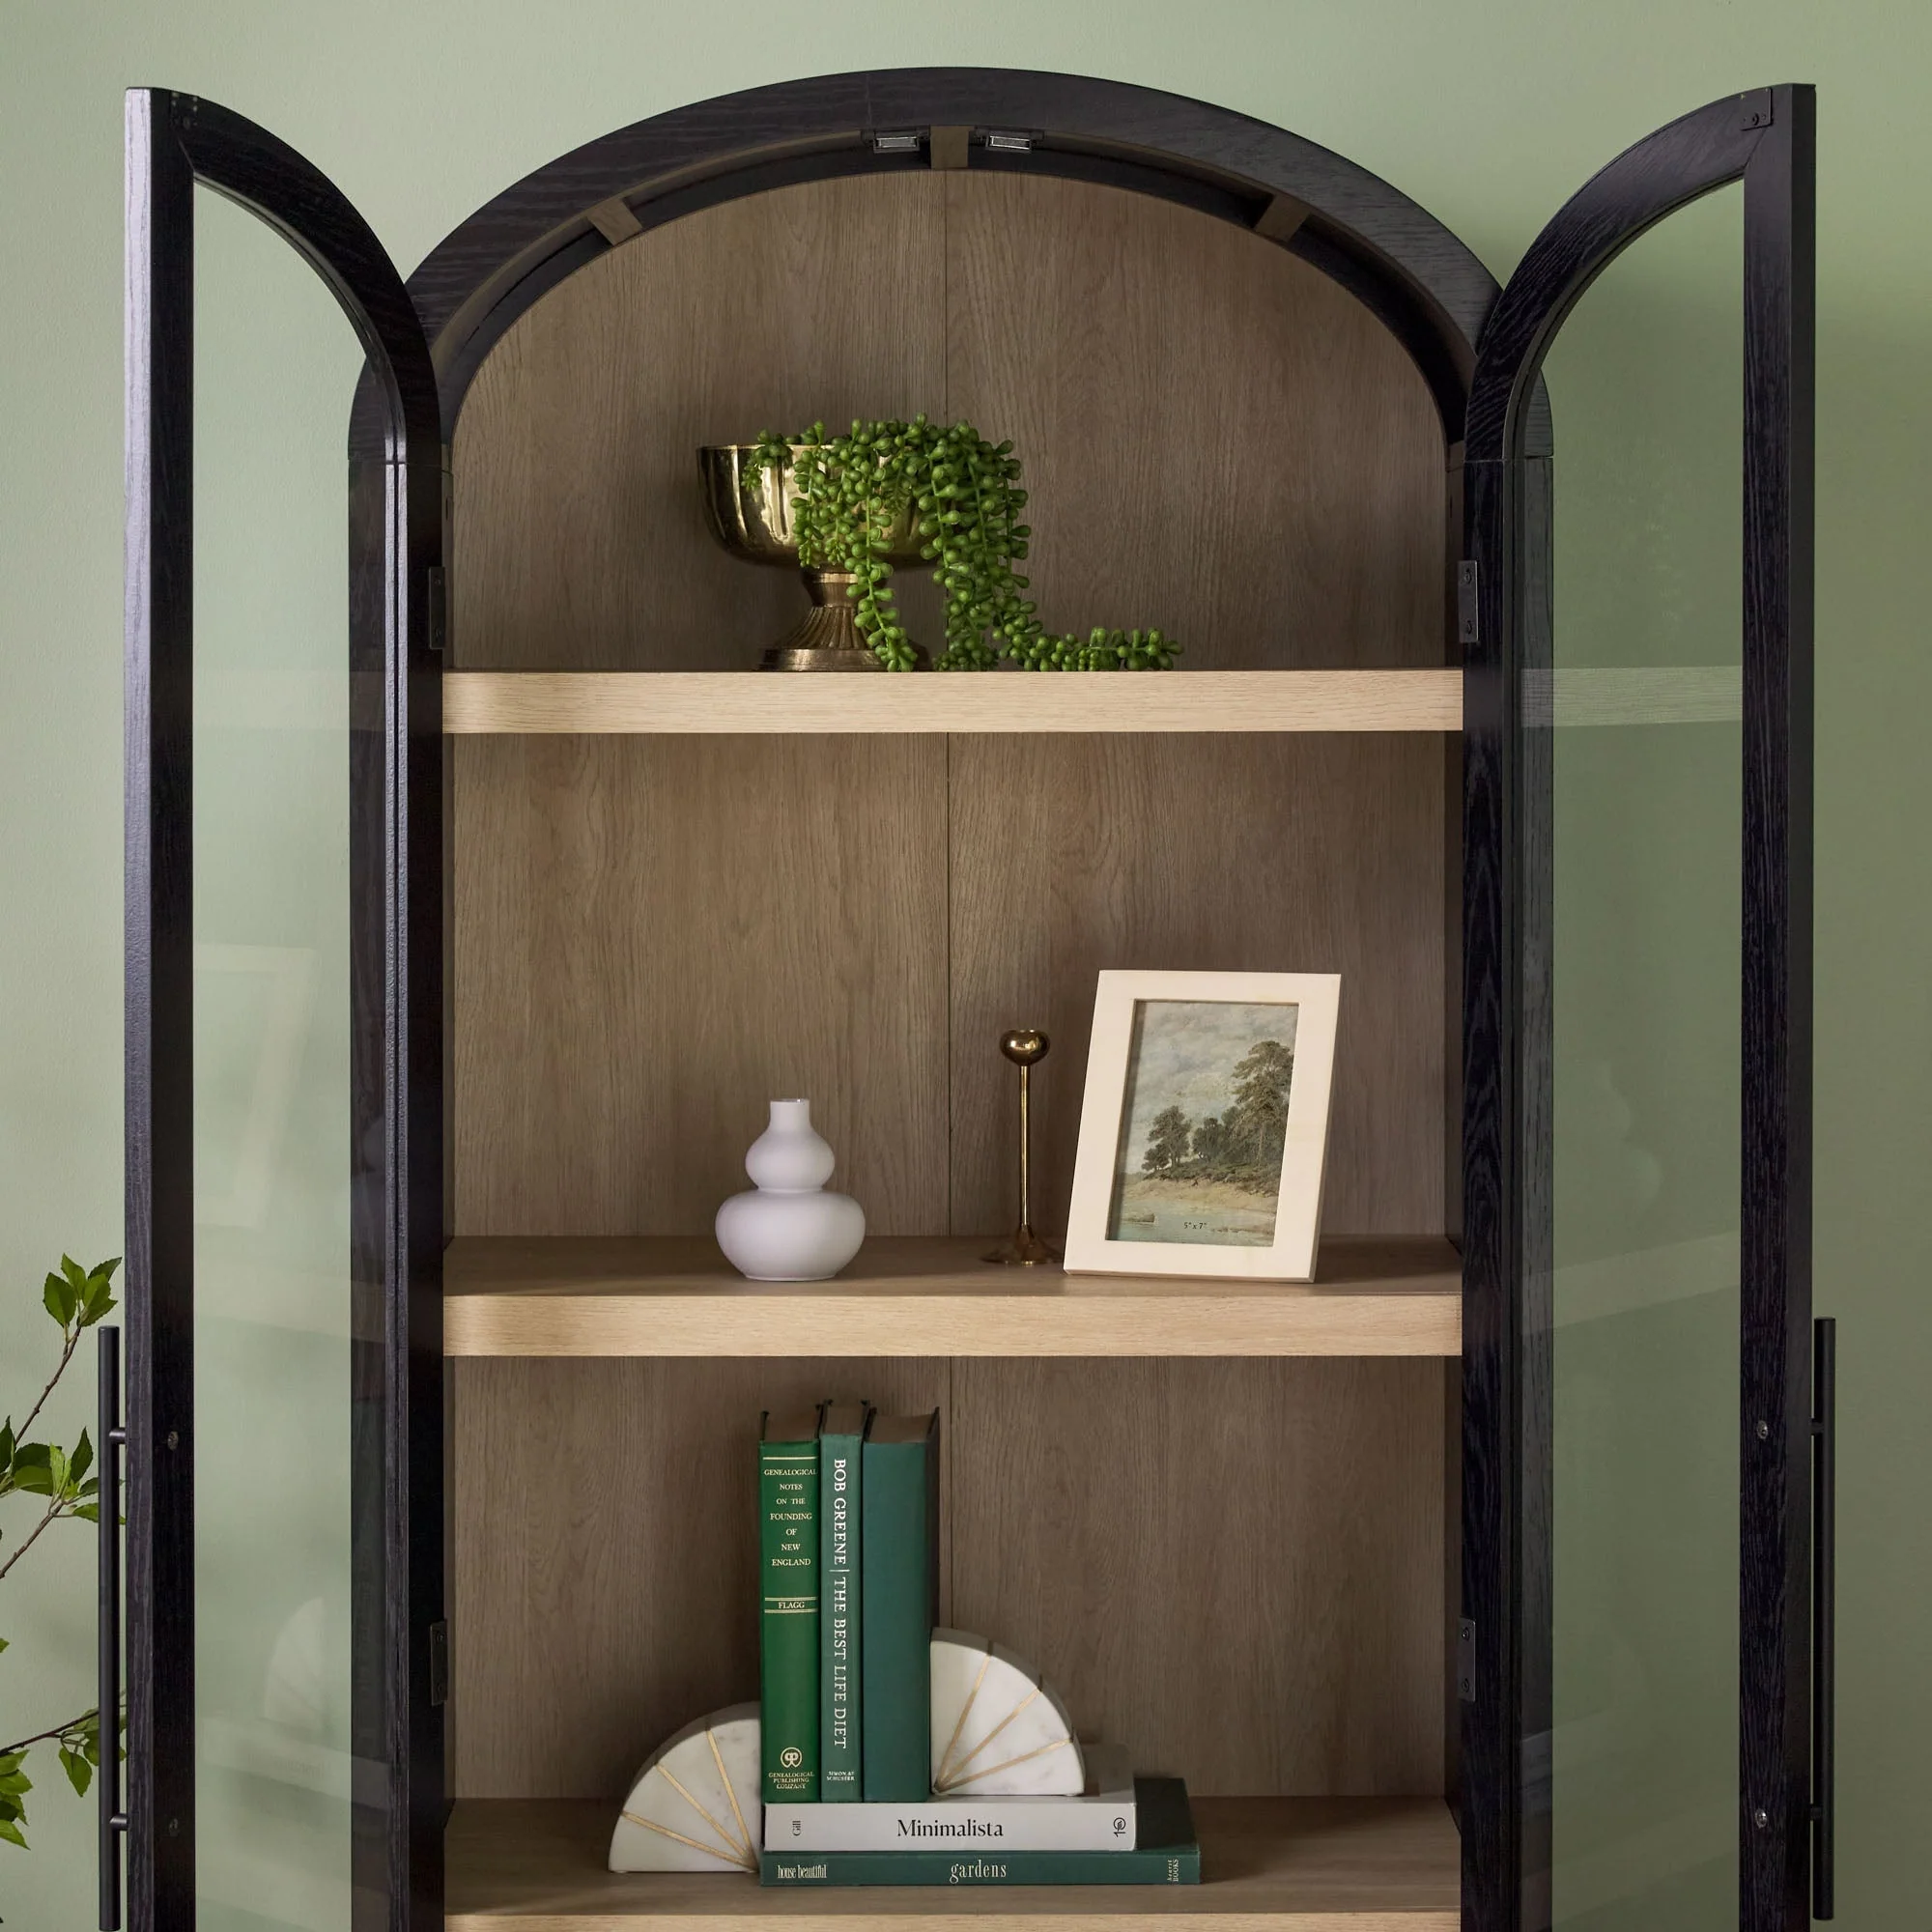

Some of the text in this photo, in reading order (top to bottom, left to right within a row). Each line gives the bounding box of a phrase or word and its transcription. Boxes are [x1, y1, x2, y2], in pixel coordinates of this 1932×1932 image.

[834, 1459, 846, 1565] BOB GREENE
[772, 1558, 811, 1567] ENGLAND
[778, 1601, 805, 1609] FLAGG
[834, 1577, 846, 1749] THE BEST LIFE DIET
[792, 1820, 801, 1836] Gill
[897, 1819, 1004, 1837] Minimalista
[778, 1864, 827, 1878] house beautiful
[950, 1860, 1007, 1884] gardens
